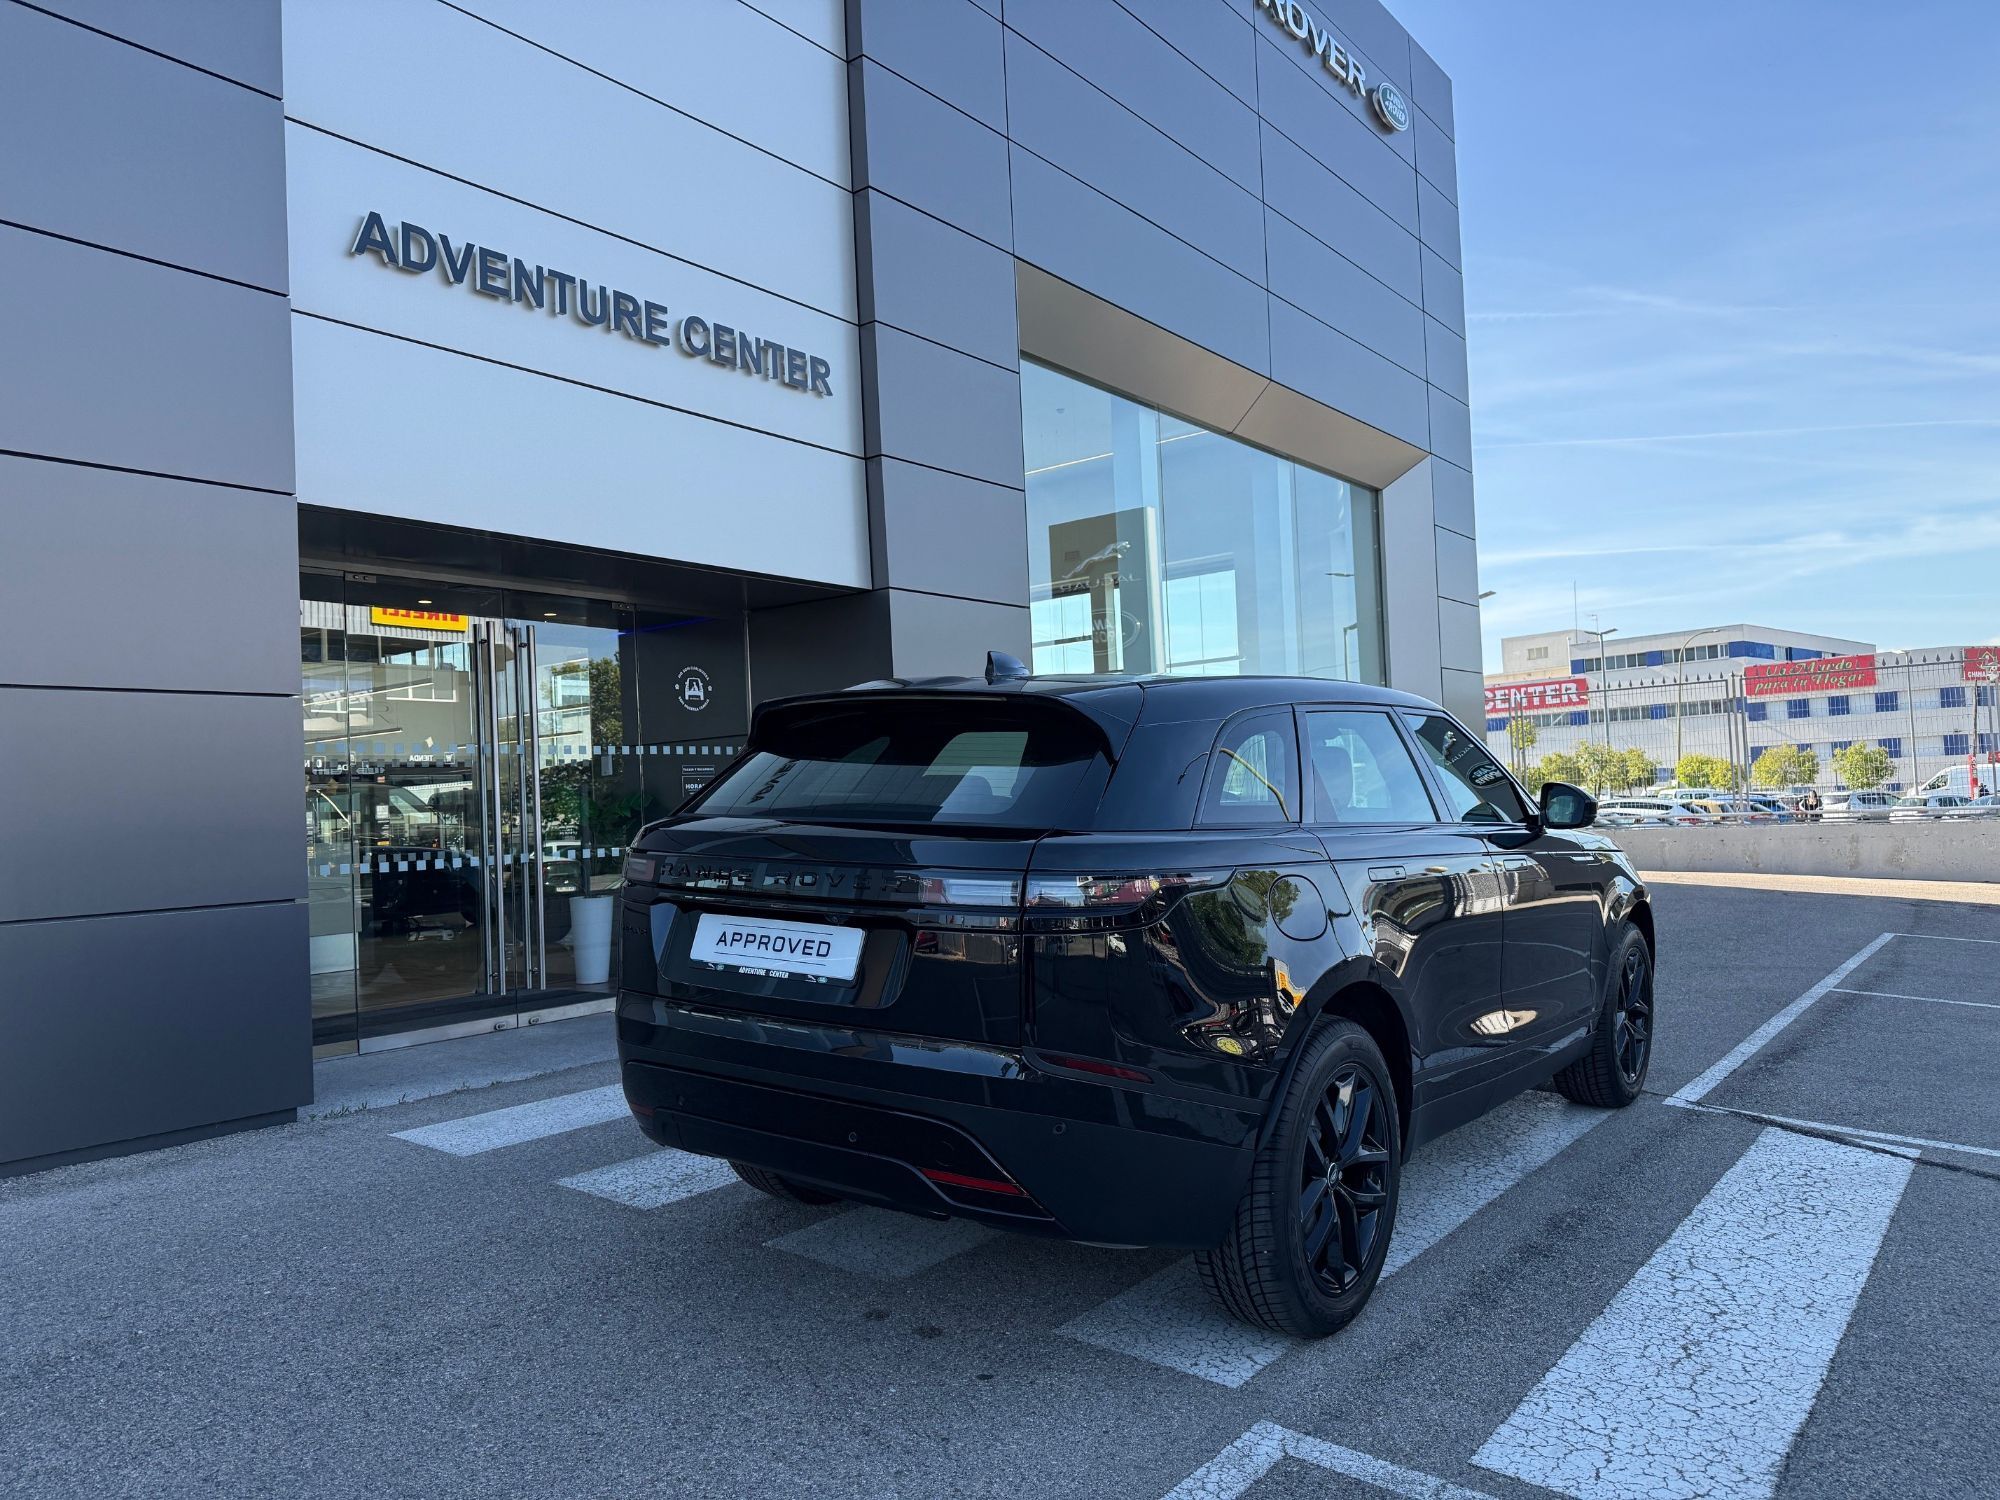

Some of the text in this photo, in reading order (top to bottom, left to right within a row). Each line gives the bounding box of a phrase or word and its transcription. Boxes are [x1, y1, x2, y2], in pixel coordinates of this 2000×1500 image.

[351, 211, 833, 396] ADVENTURE CENTER
[1755, 680, 1788, 695] para
[1793, 677, 1808, 687] tu
[716, 930, 831, 958] APPROVED
[738, 966, 789, 979] ADVENTURE CENTER
